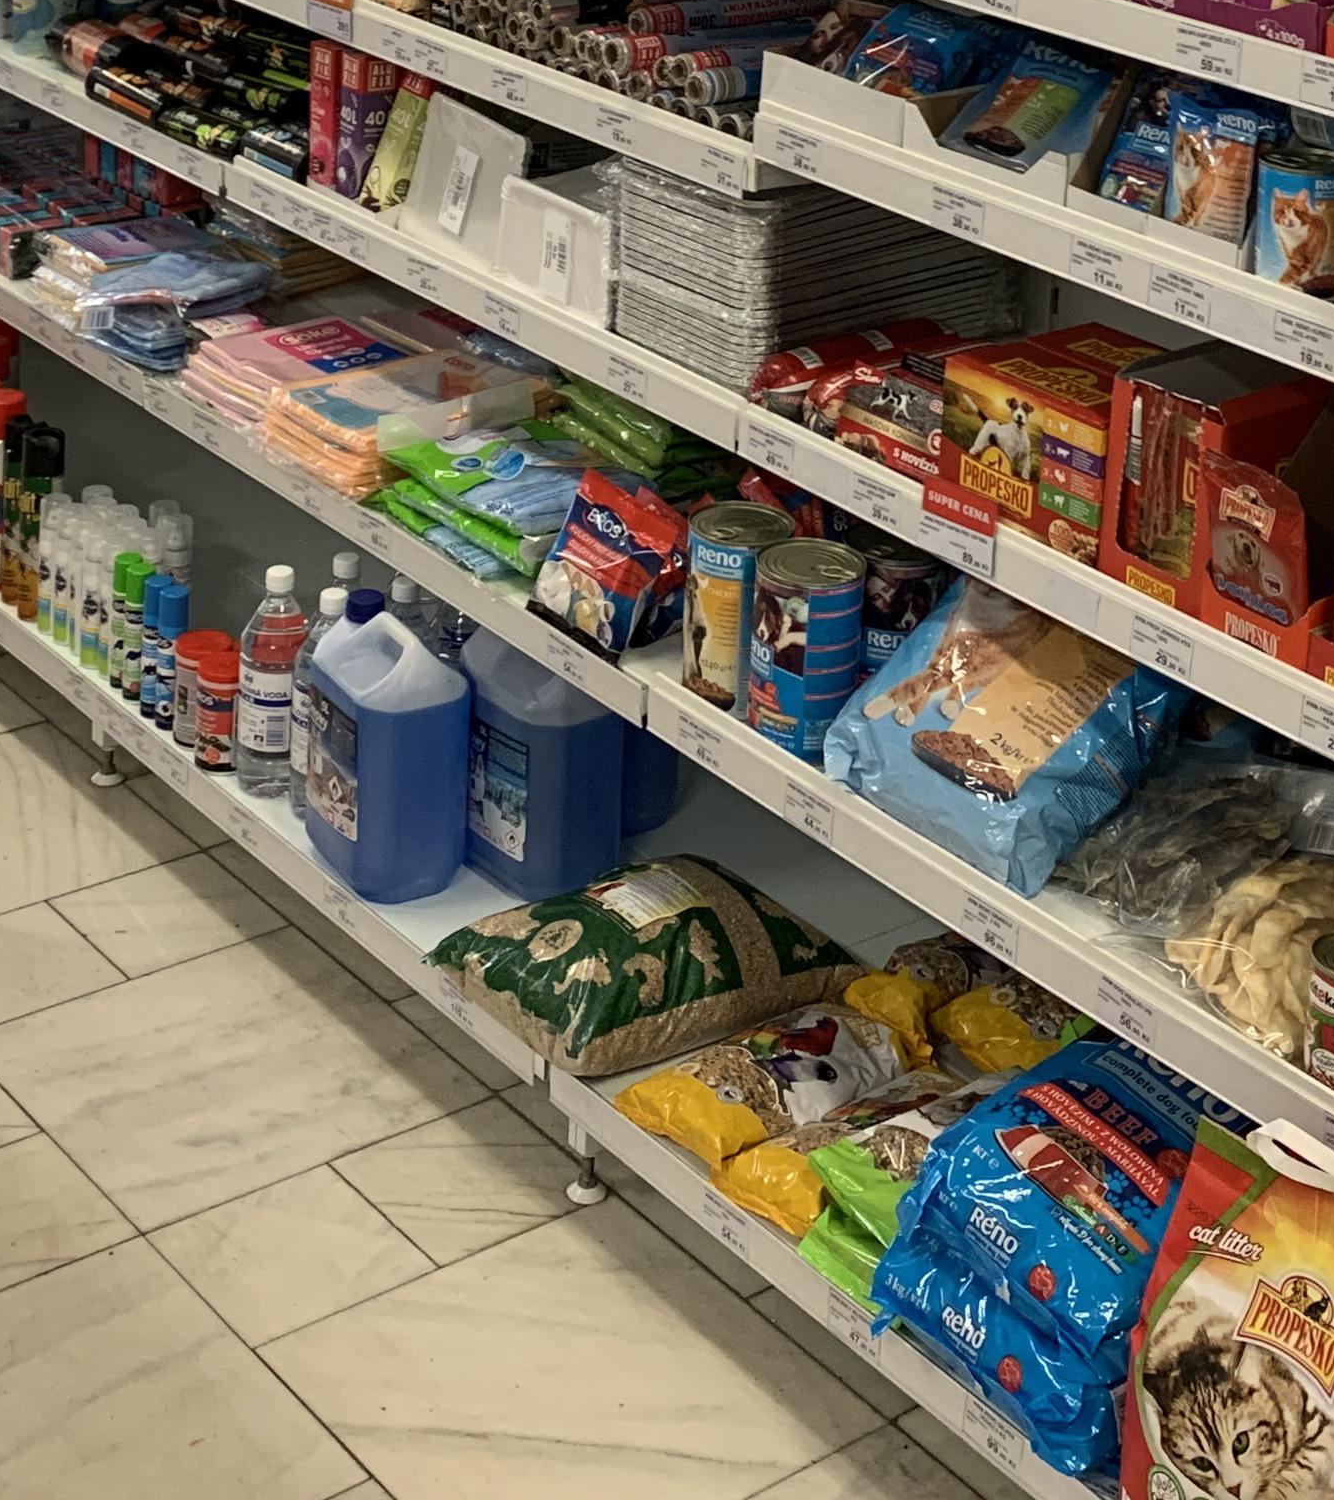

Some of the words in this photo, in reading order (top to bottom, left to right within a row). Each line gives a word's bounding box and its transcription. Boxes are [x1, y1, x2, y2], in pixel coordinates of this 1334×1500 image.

[1217, 112, 1256, 132] Reno
[963, 457, 1030, 513] PROPESKO
[928, 490, 961, 513] SUPER
[963, 501, 990, 525] CENA
[697, 543, 743, 567] Reno
[1126, 569, 1175, 604] PROPESKO
[1224, 611, 1281, 656] PROPESKO
[1101, 1053, 1156, 1094] complete
[1157, 1089, 1179, 1115] dog
[1084, 1088, 1158, 1145] BEEF
[1188, 1223, 1221, 1252] cat
[1218, 1228, 1264, 1262] litter
